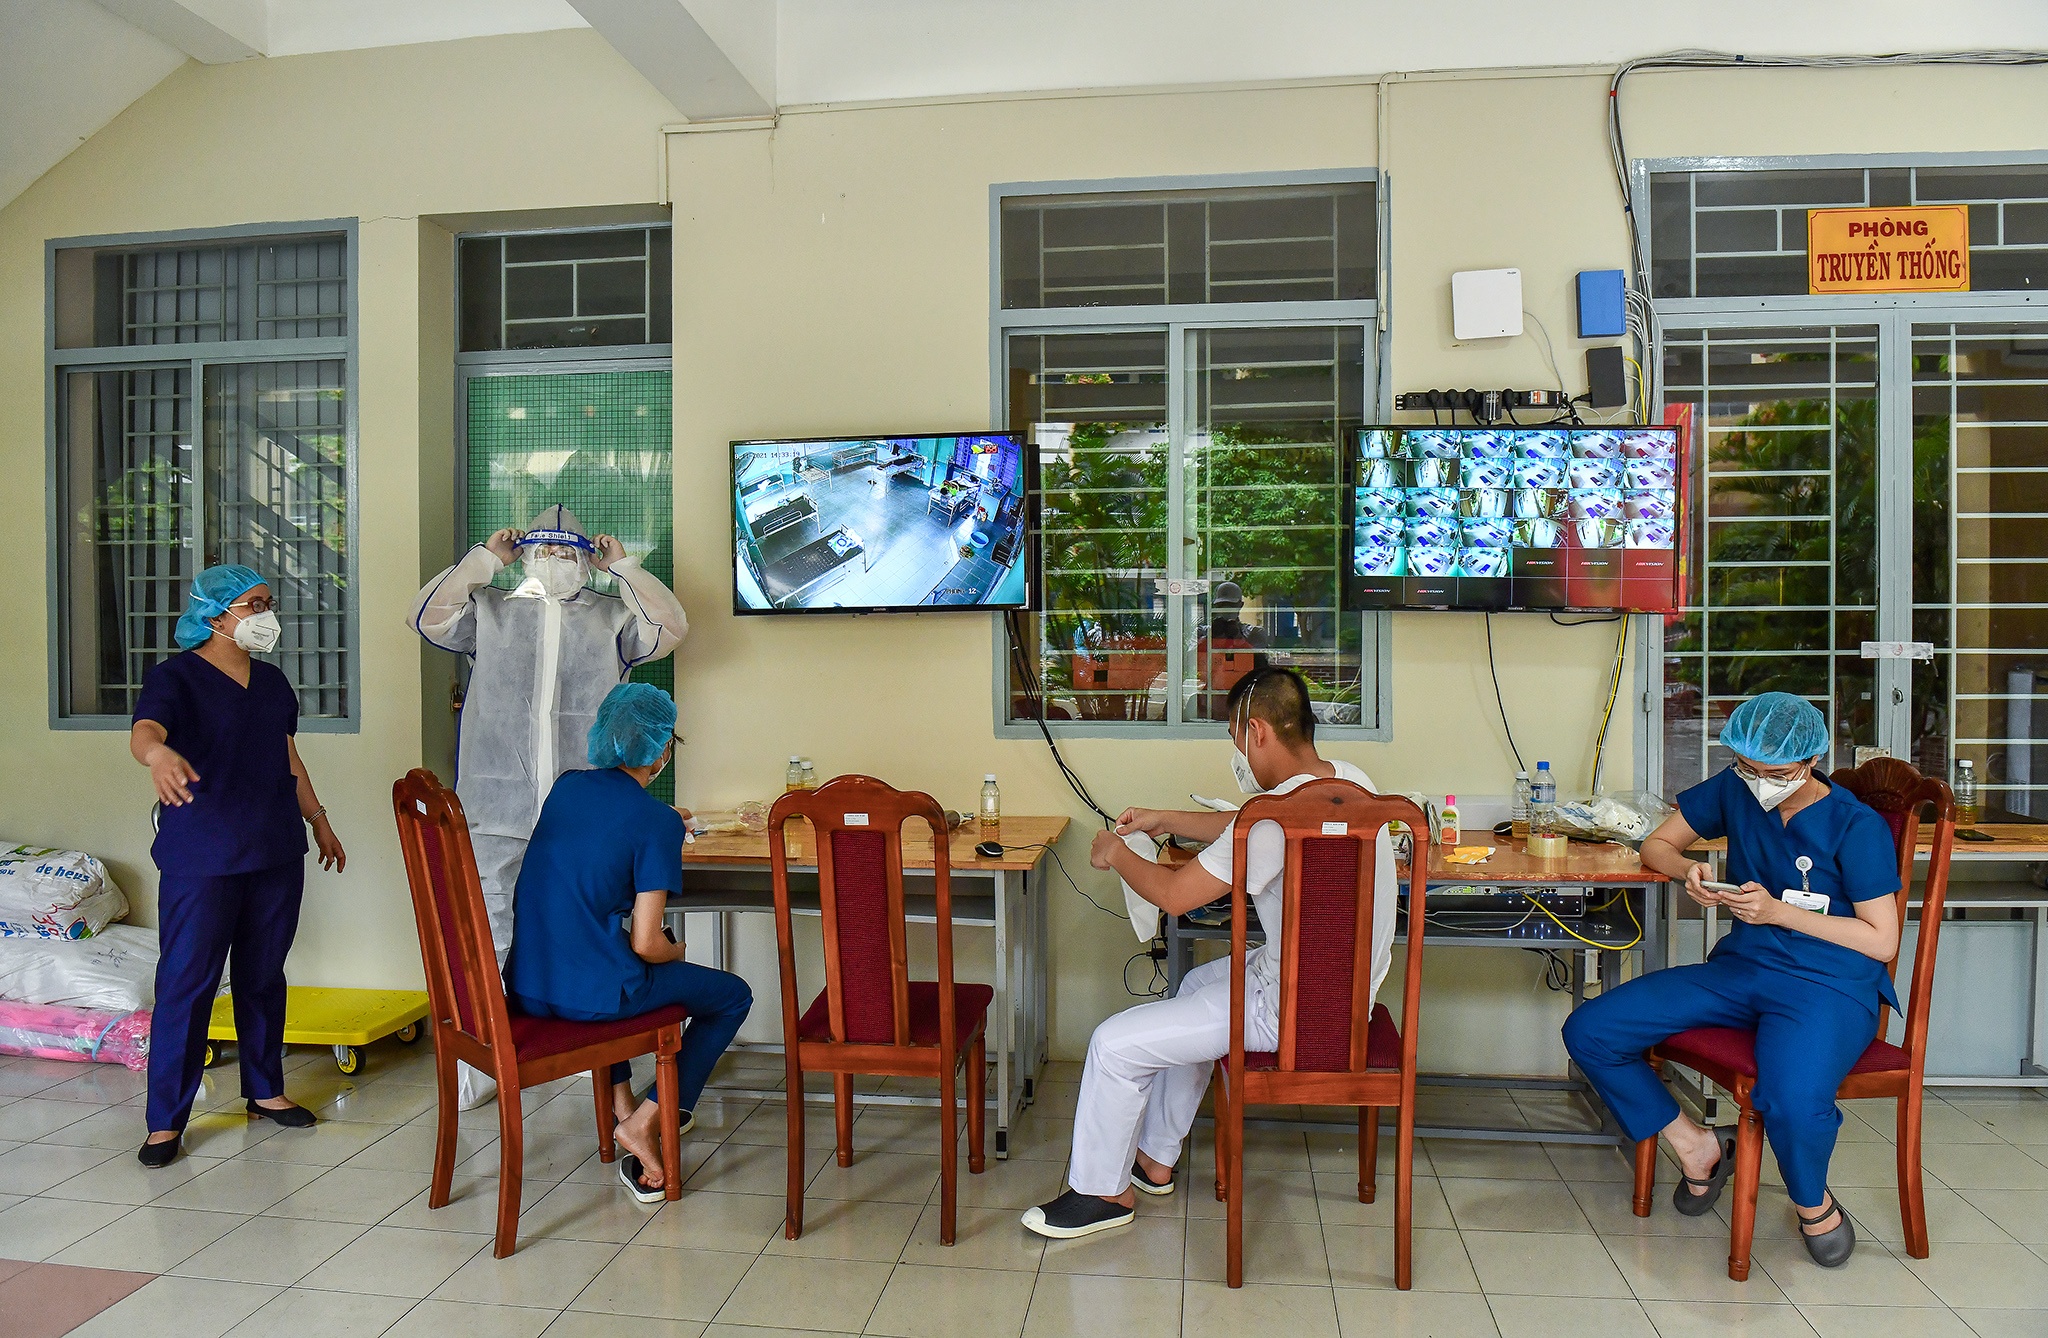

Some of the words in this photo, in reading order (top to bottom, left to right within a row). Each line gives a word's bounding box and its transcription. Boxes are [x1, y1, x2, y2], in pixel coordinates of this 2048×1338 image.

[1848, 216, 1929, 238] PHÒNG
[1816, 239, 1891, 282] TRUYỀN
[1896, 237, 1961, 281] THỐNG
[968, 587, 977, 595] 12
[35, 863, 53, 875] de
[54, 866, 91, 883] heus
